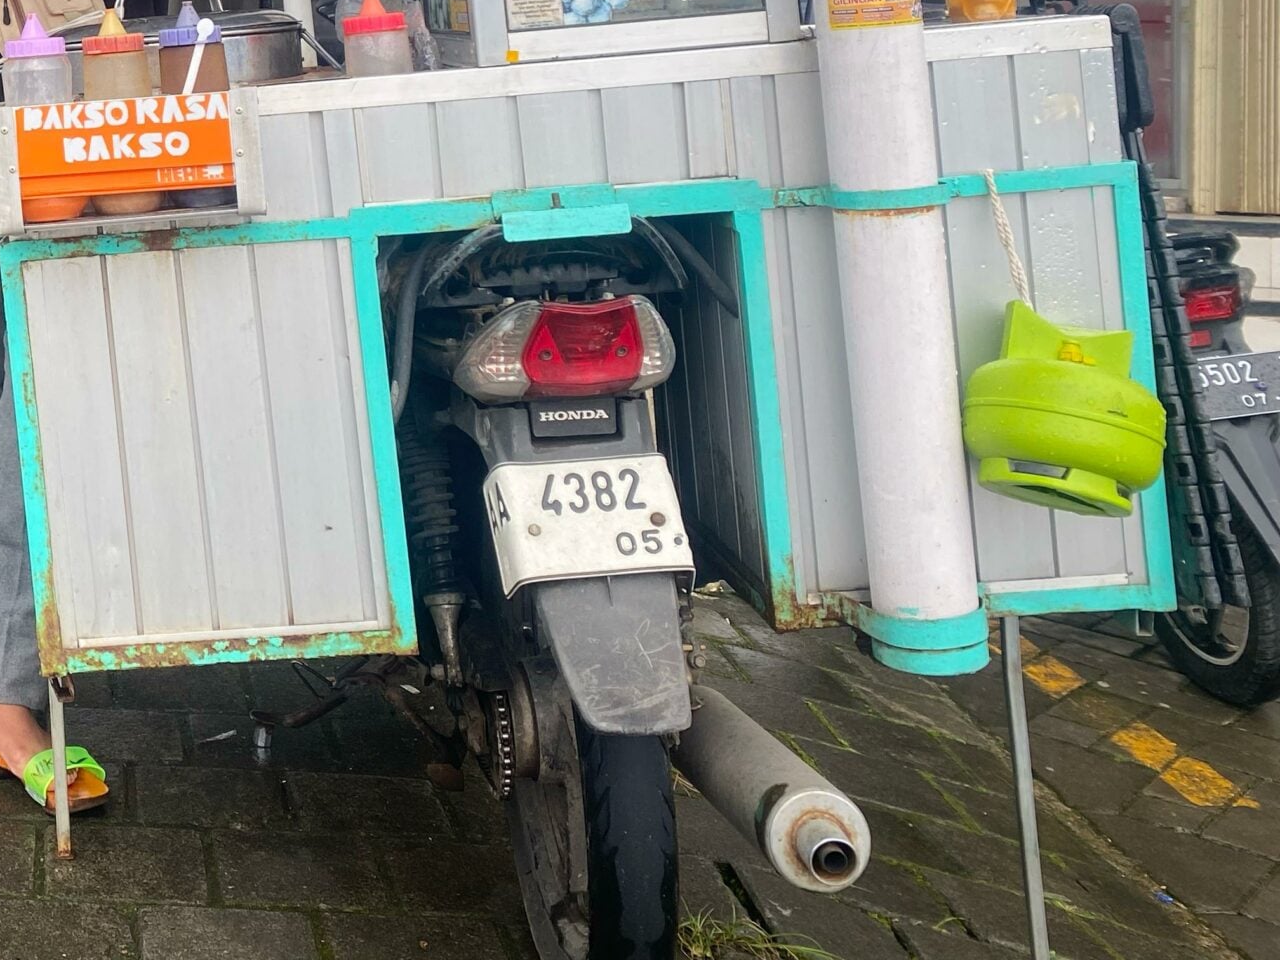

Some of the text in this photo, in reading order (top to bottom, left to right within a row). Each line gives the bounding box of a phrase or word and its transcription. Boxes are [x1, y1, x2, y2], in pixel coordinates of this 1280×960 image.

[23, 93, 228, 131] BAKSO RASA
[63, 131, 190, 163] BAKSO
[539, 408, 609, 422] HONDA
[1241, 392, 1267, 408] 07
[540, 468, 647, 516] 4382
[616, 529, 663, 557] 05
